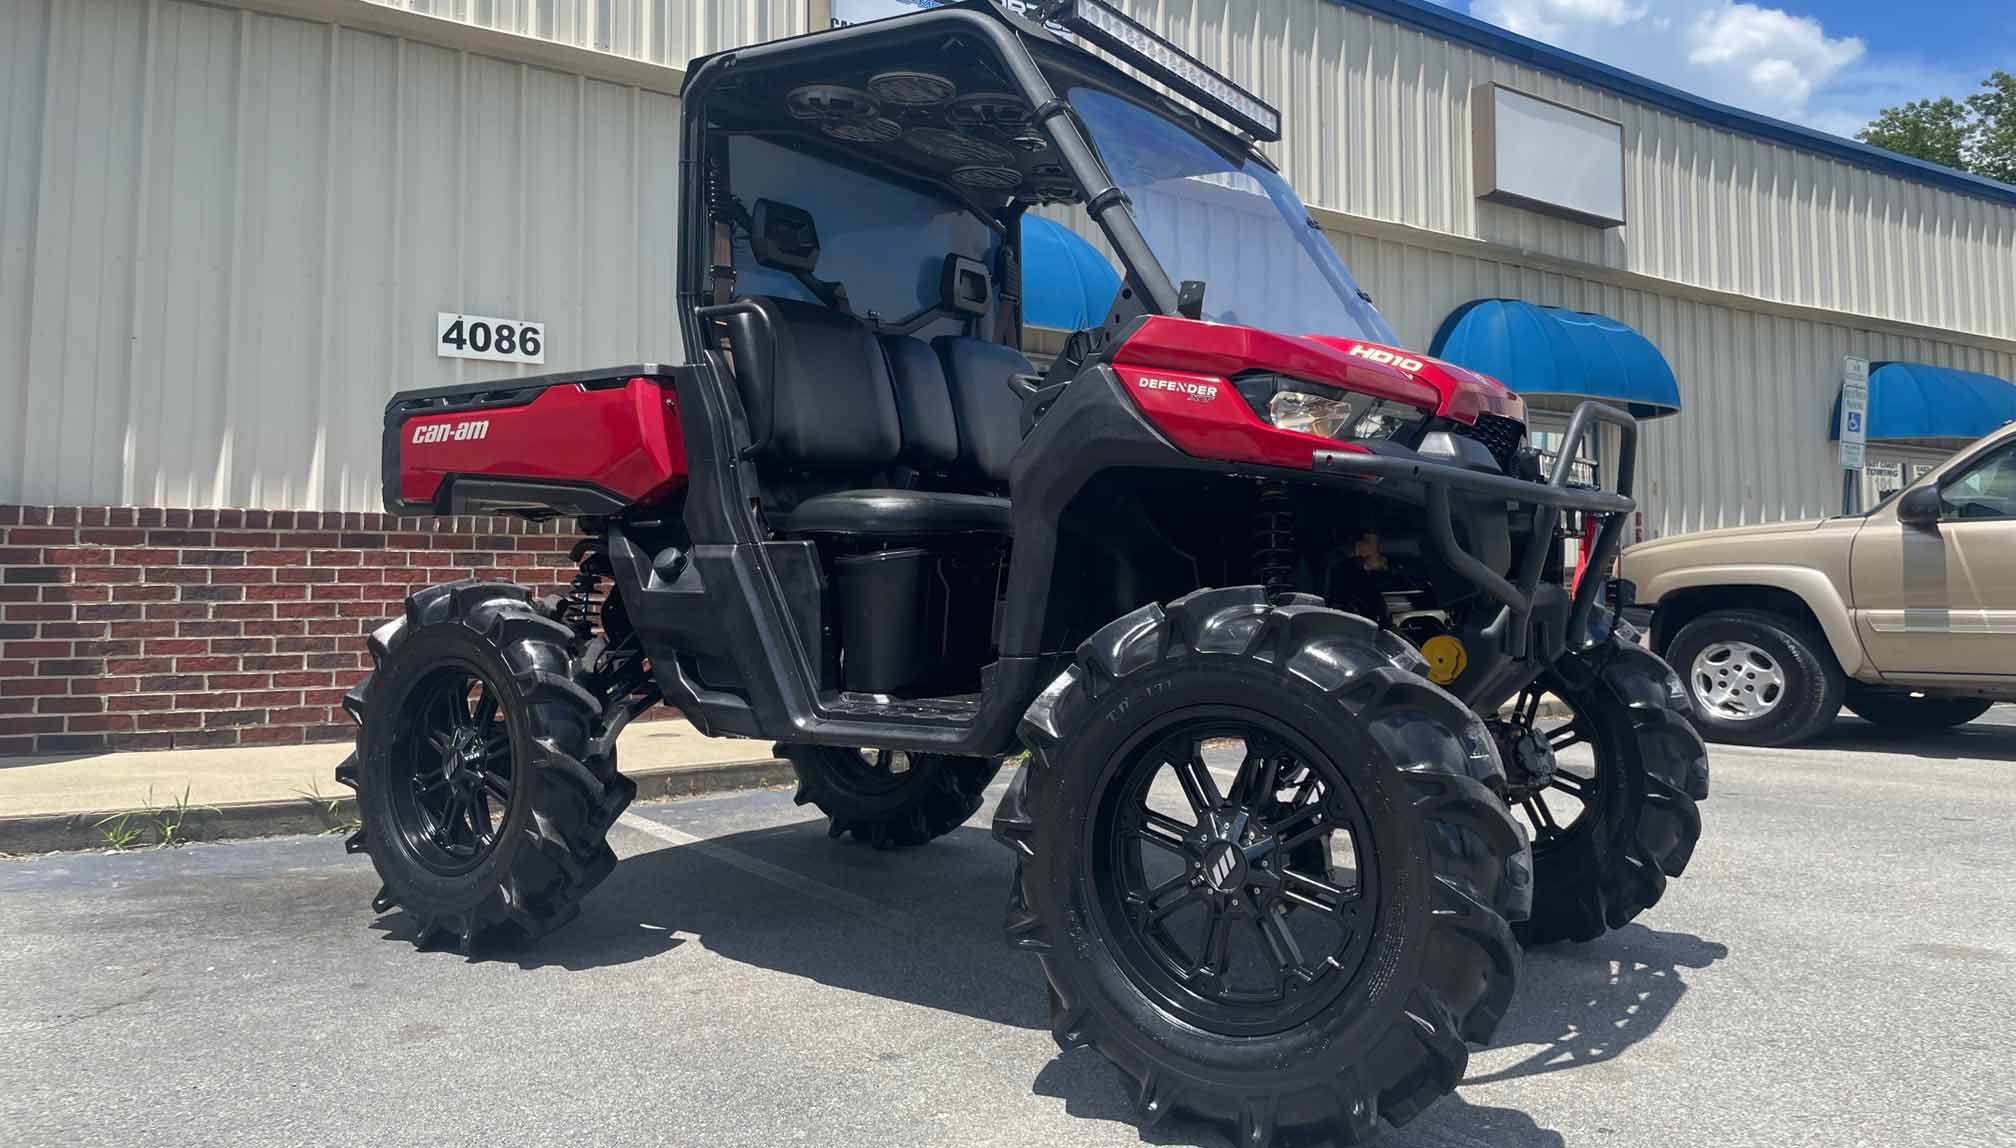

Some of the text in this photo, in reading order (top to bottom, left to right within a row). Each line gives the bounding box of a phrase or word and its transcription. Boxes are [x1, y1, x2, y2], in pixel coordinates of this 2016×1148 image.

[442, 319, 541, 356] 4086
[1349, 345, 1423, 372] HD10
[1138, 377, 1218, 397] DEFENDER
[412, 420, 489, 444] can-am
